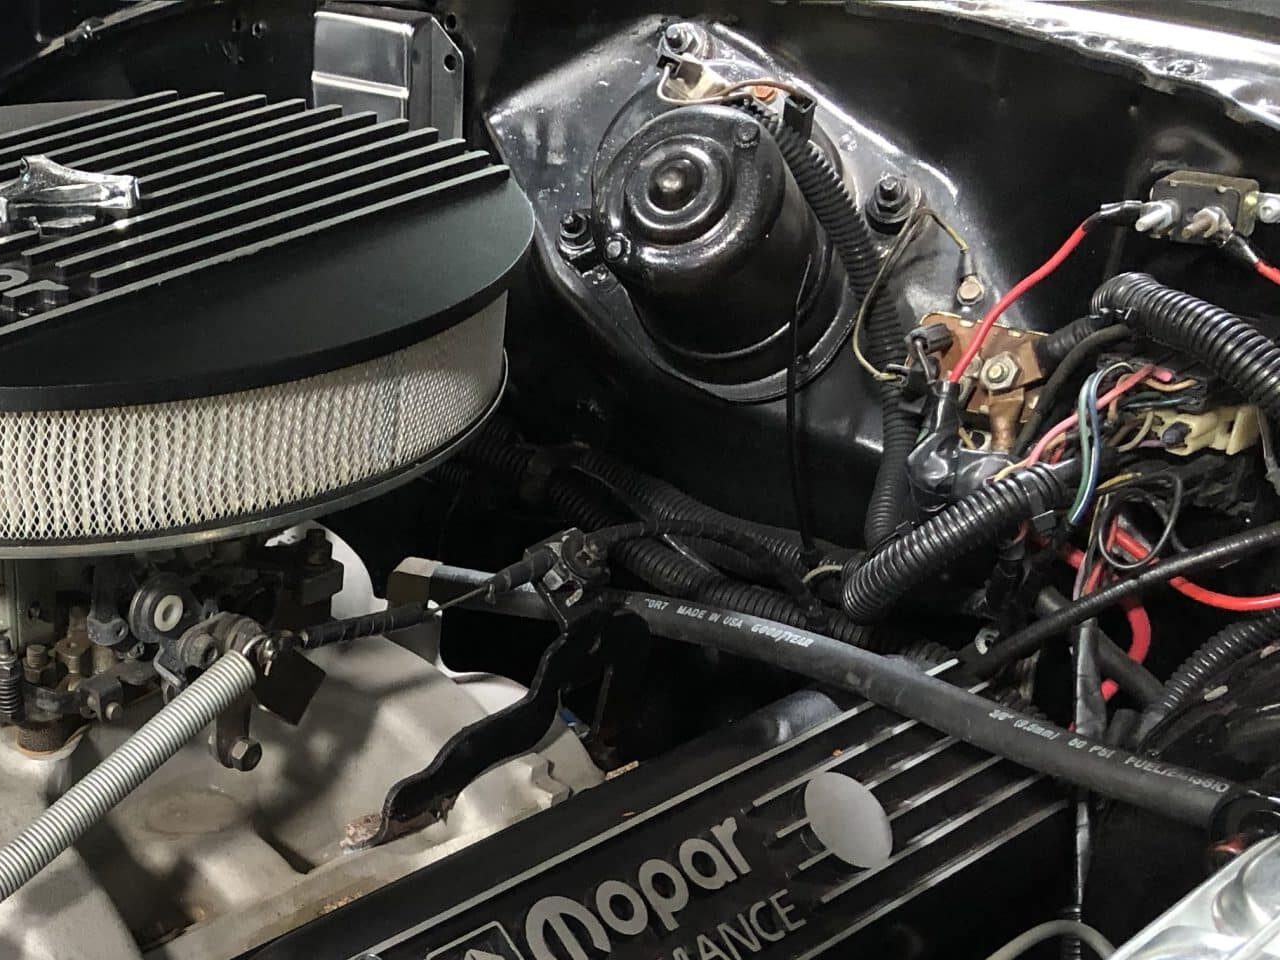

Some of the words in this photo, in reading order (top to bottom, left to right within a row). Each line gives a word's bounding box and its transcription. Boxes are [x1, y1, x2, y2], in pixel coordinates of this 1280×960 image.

[676, 605, 706, 621] MADE
[723, 615, 744, 630] USA
[751, 622, 814, 648] GOODYEAR
